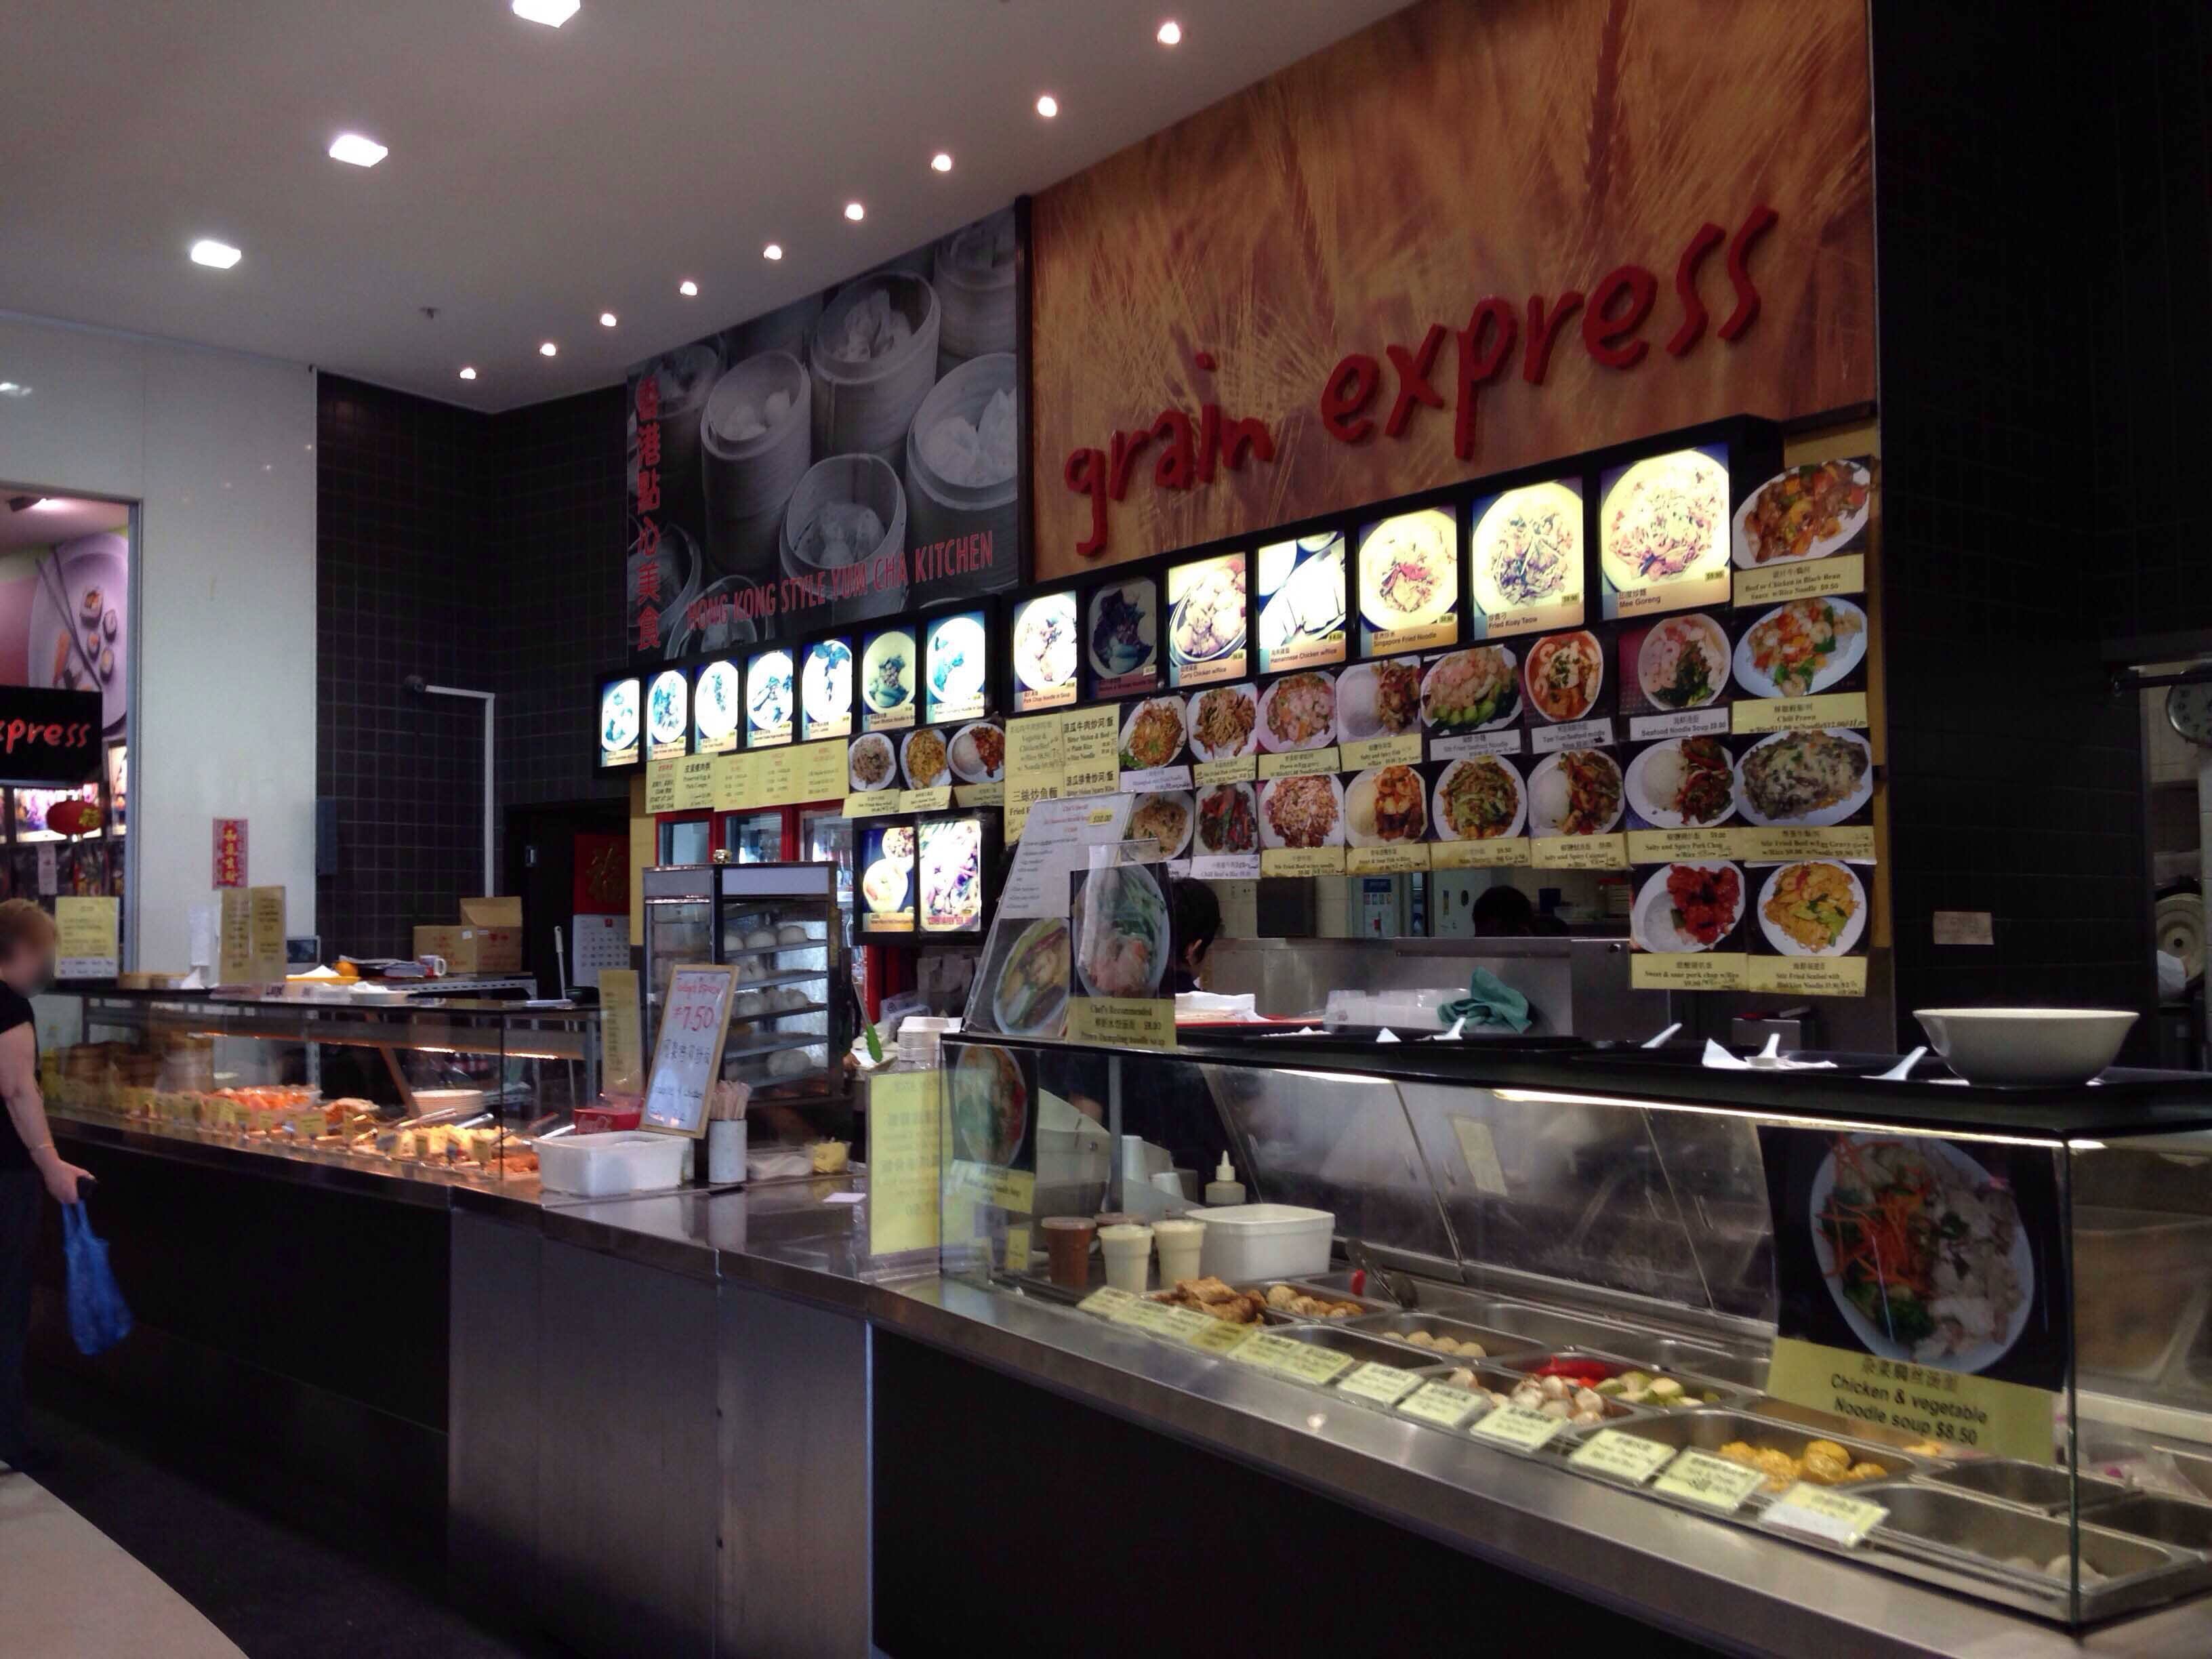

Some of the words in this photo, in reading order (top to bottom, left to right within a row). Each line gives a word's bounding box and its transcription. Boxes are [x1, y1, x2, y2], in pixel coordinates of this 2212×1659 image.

[1065, 352, 1274, 557] grain
[1322, 203, 1779, 459] express
[636, 376, 661, 651] 香港點心美食
[686, 593, 727, 630] HONG
[733, 584, 776, 620] KONG
[781, 570, 827, 613] STYLE
[828, 562, 867, 599] YUM
[872, 553, 907, 591] CHA
[915, 530, 994, 582] KITCHEN
[1804, 575, 1821, 583] Black
[1635, 596, 1661, 606] Goreng
[1374, 638, 1401, 647] Singapore
[1418, 632, 1437, 640] Noodle
[1300, 651, 1319, 659] Chicken
[1193, 669, 1210, 677] Chicken
[1641, 728, 1668, 736] Seafood
[1670, 725, 1691, 734] Noodle
[1692, 724, 1708, 732] Soup
[1009, 807, 1025, 816] Fried
[1831, 1373, 1889, 1402] Chicken
[1895, 1389, 1905, 1404] &
[1911, 1396, 1988, 1425] vegetable
[1835, 1396, 1887, 1425] Noodle
[1891, 1412, 1931, 1435] soup
[1936, 1422, 1978, 1446] $8.50
